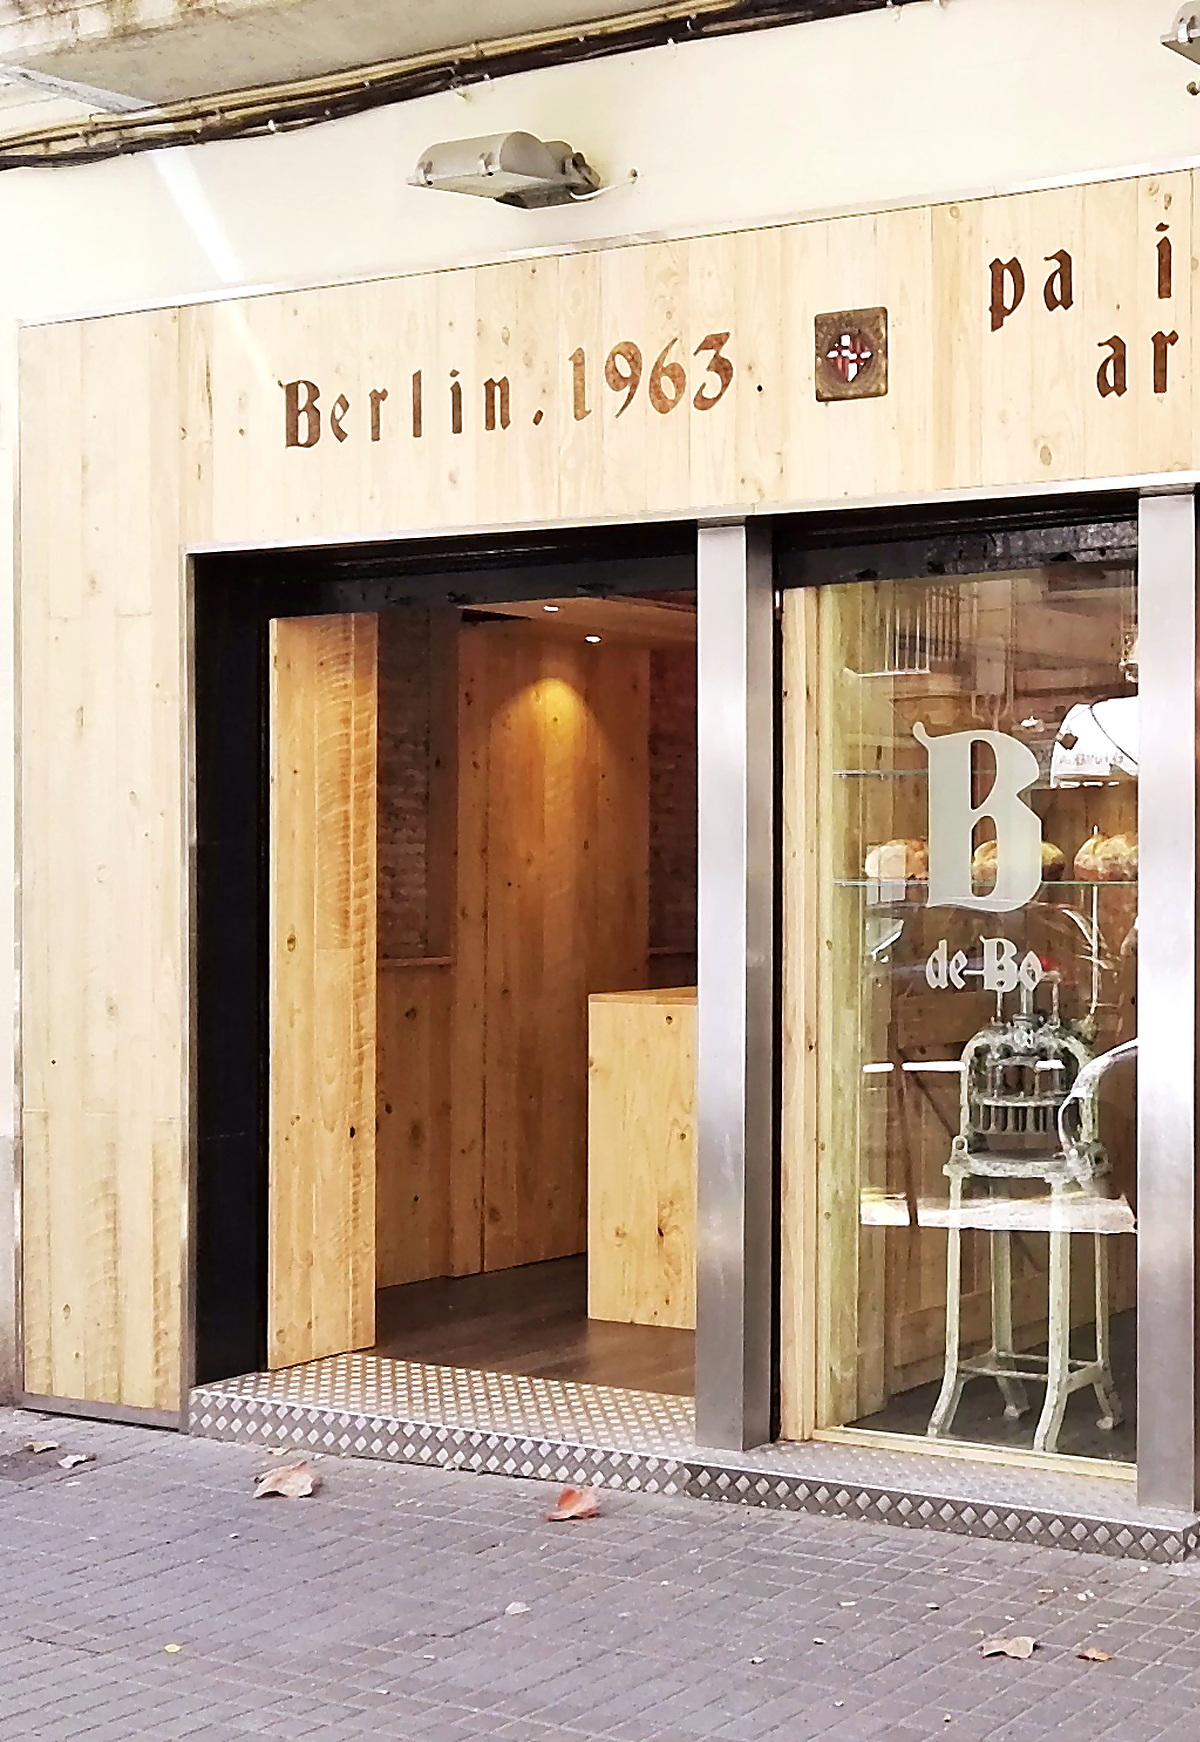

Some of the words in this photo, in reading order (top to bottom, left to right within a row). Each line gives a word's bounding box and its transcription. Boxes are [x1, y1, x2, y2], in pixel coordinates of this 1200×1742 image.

[988, 248, 1074, 331] pa
[1154, 223, 1173, 299] i
[568, 332, 734, 421] 1963
[912, 721, 1042, 913] B
[925, 939, 968, 990] de
[979, 935, 1043, 993] Bo
